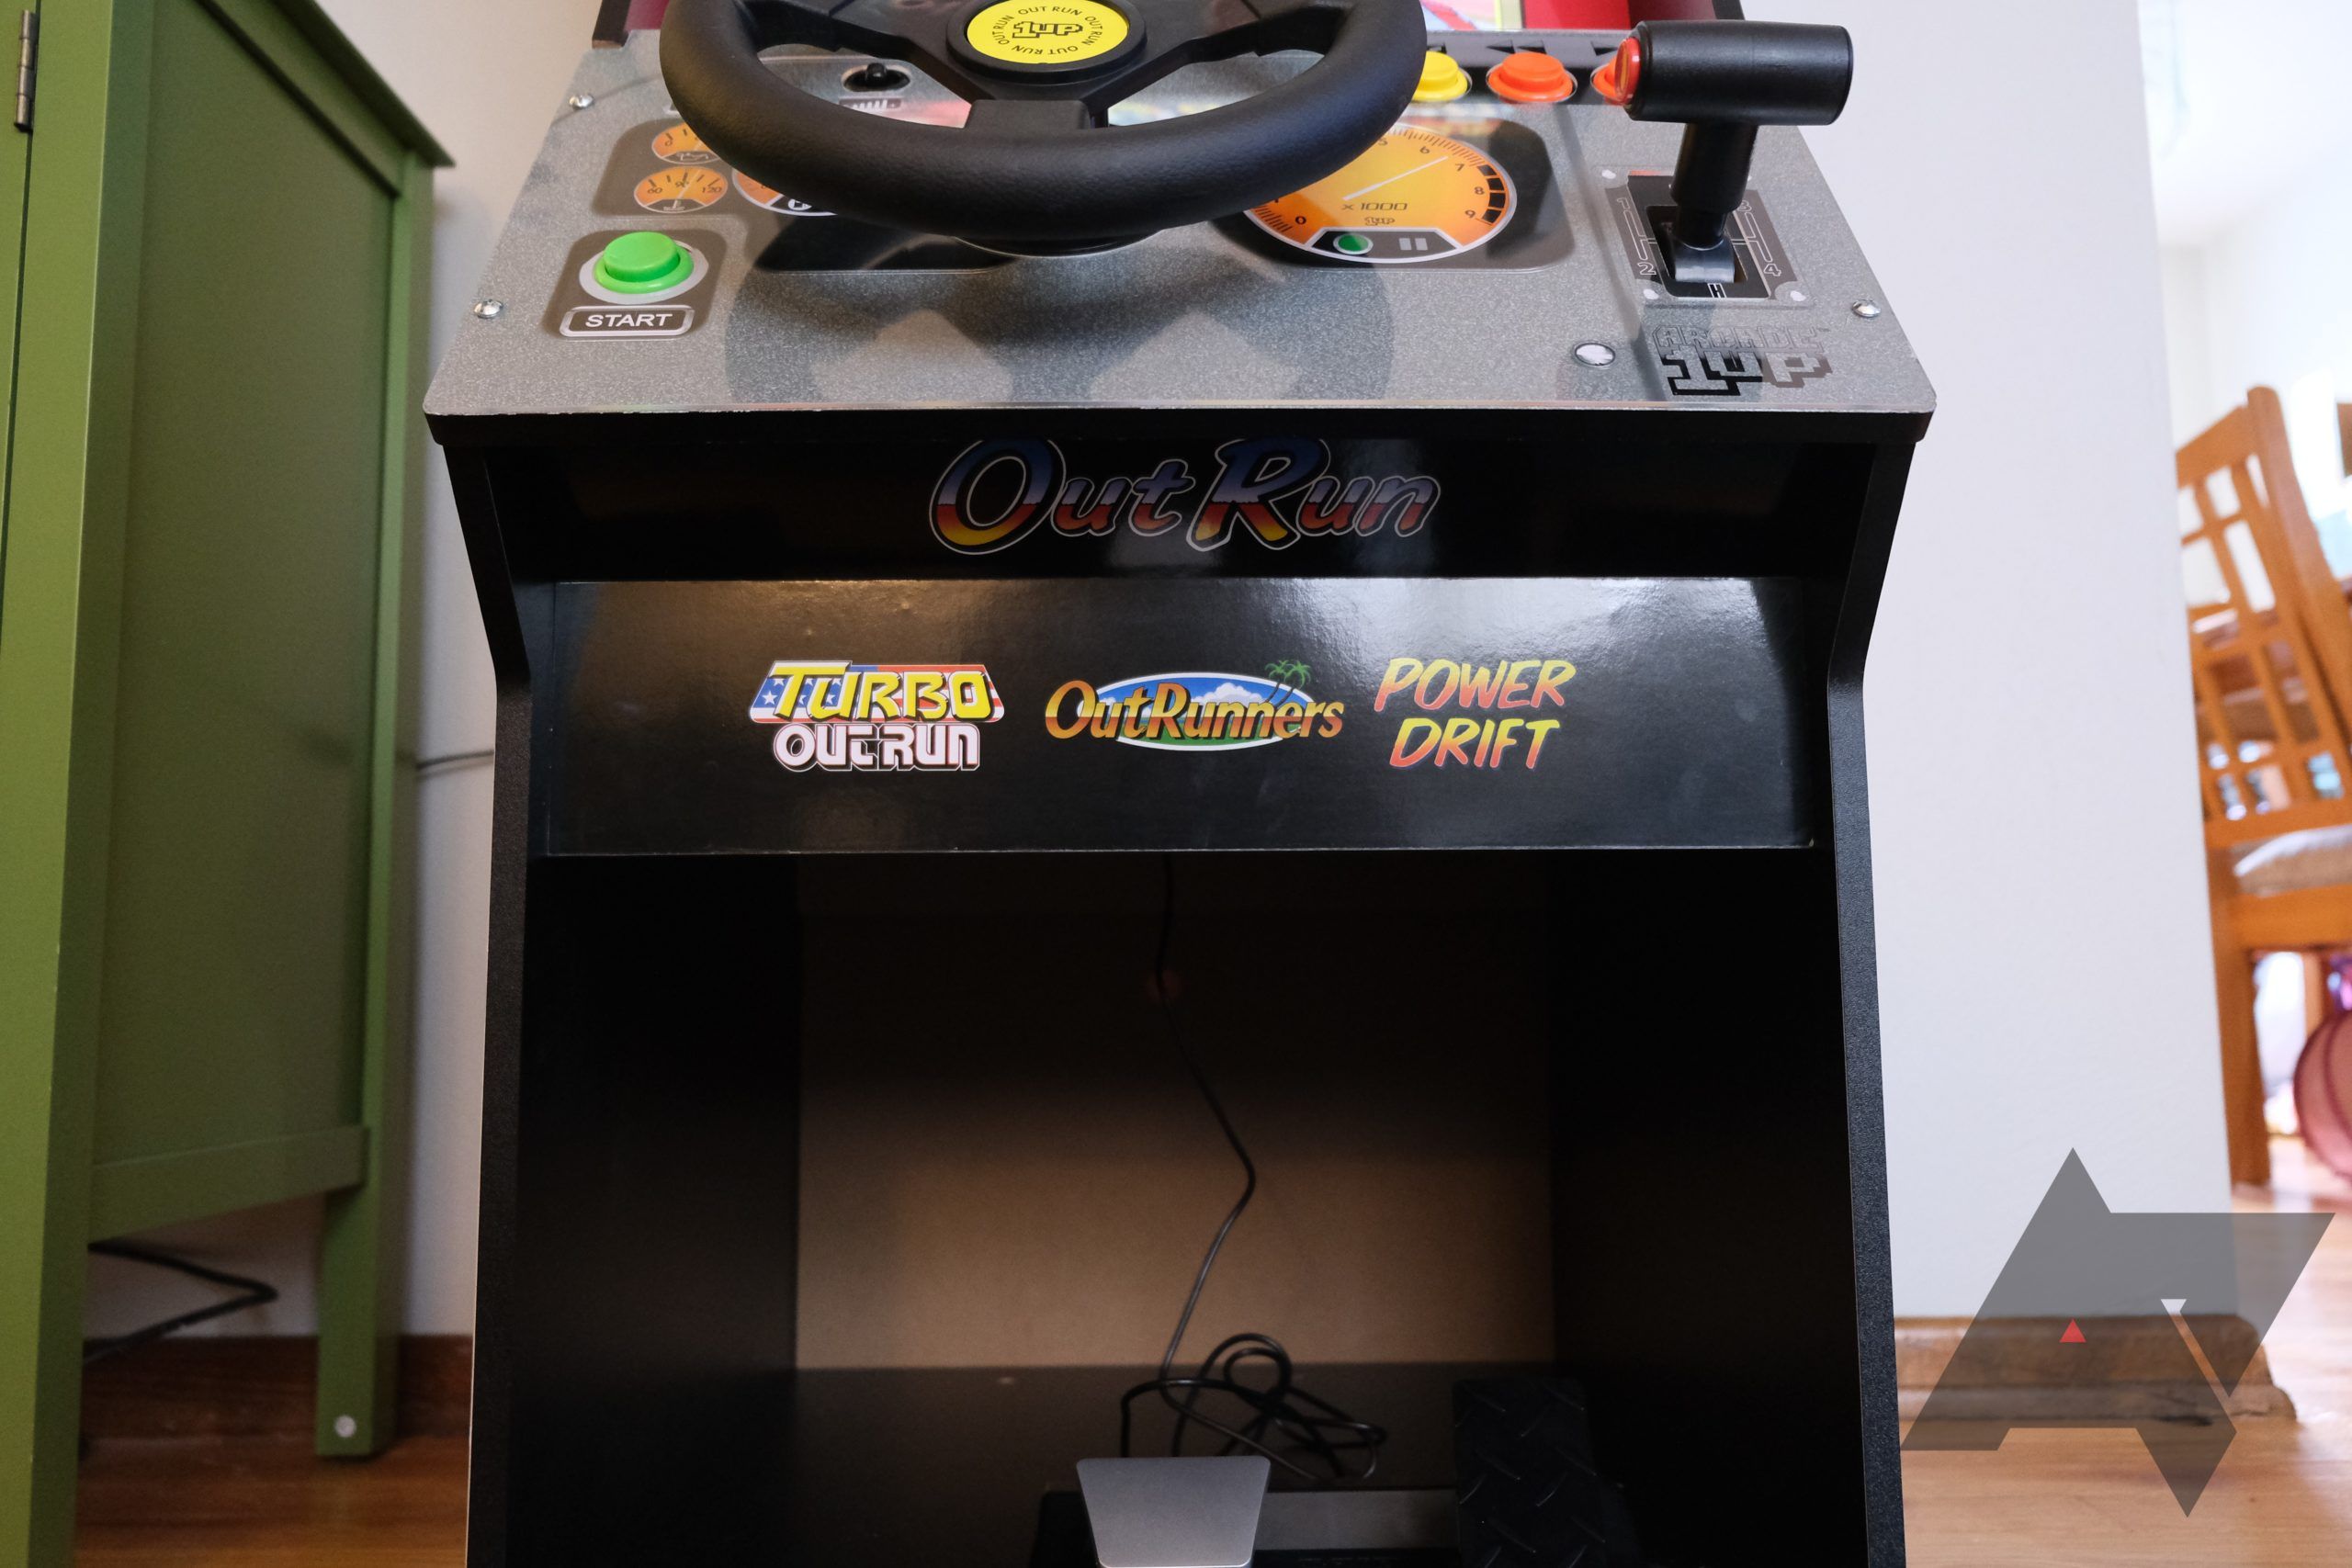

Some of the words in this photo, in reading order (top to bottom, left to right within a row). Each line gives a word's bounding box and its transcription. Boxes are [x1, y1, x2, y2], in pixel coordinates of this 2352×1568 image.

[1018, 6, 1047, 15] OUT
[1052, 6, 1082, 16] RUN
[993, 15, 1014, 29] RUN
[1085, 16, 1102, 29] OUT
[1012, 21, 1083, 39] 1UP
[992, 31, 1010, 45] OUT
[1081, 30, 1102, 45] RUN
[1012, 45, 1043, 55] RUN
[1047, 45, 1079, 55] OUT
[1419, 145, 1430, 154] 6
[1474, 186, 1485, 195] 8
[1360, 202, 1408, 211] 1000
[1295, 216, 1307, 225] 0
[1464, 209, 1476, 219] 9
[1636, 262, 1657, 276] 2
[1763, 263, 1782, 276] 4
[584, 312, 673, 328] START
[1652, 325, 1825, 353] ARCADE
[1660, 345, 1833, 396] 1UP
[929, 439, 1195, 555] Out
[1186, 439, 1441, 552] Run
[768, 660, 996, 722] TURBO
[1374, 658, 1577, 712] POWER
[1045, 680, 1345, 739] OutRunners
[1389, 717, 1560, 770] DRIFT
